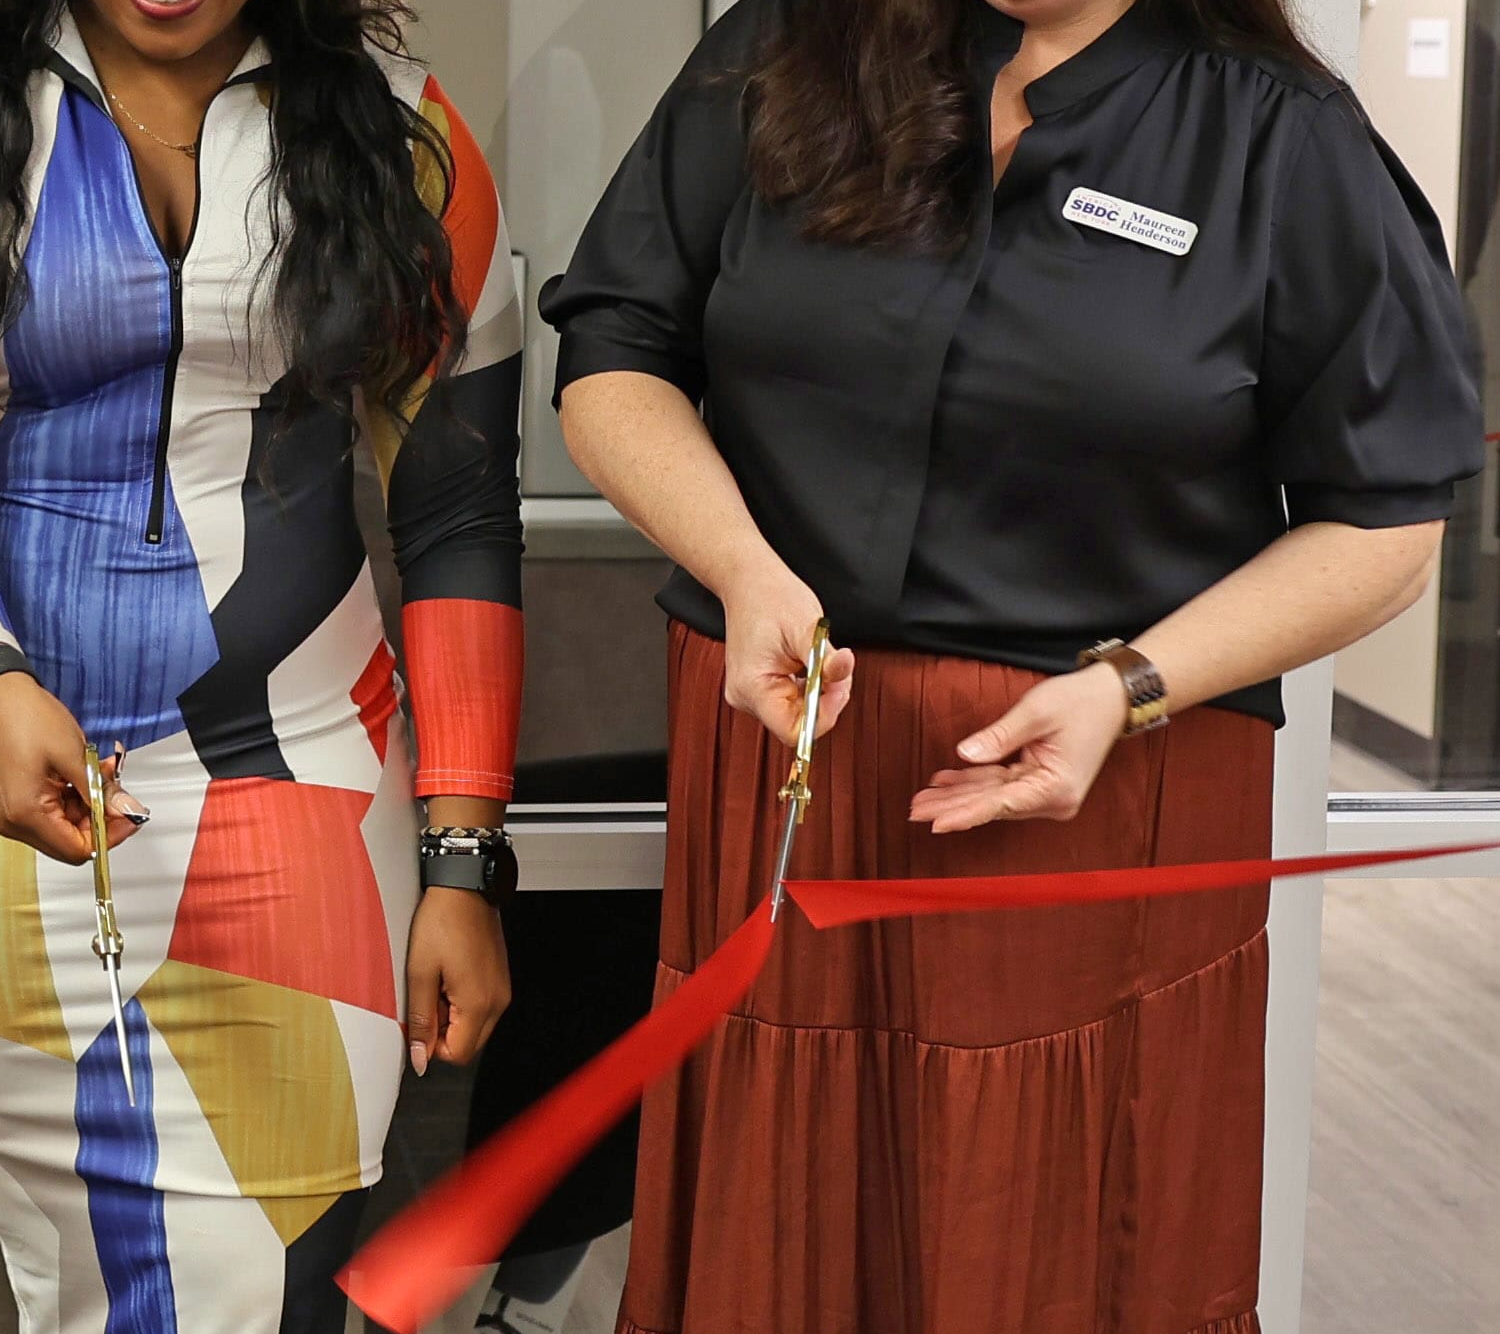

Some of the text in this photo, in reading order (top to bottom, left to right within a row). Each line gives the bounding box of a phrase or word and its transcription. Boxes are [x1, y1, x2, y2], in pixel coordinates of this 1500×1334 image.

[1069, 198, 1120, 222] SBDC
[1120, 219, 1187, 249] Henderson
[1129, 211, 1186, 238] Maureen
